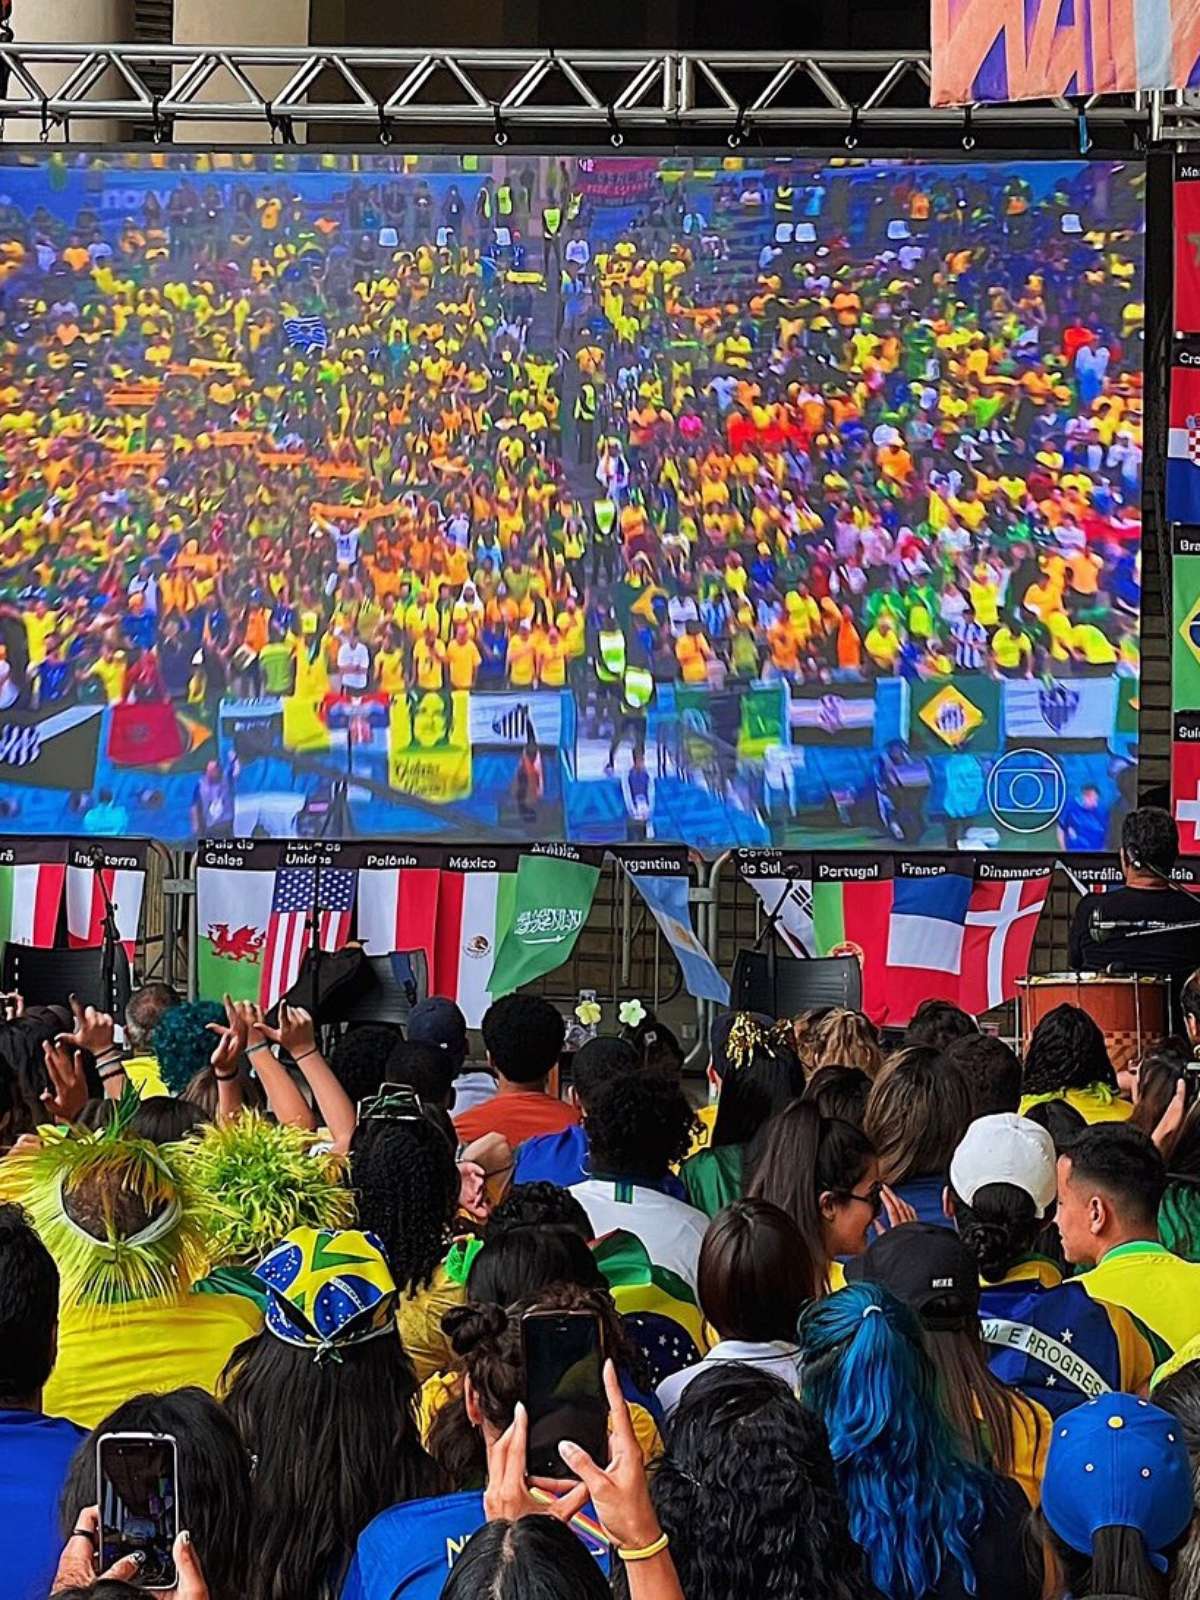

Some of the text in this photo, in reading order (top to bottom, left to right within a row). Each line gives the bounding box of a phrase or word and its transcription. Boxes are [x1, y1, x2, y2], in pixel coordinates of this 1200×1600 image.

[74, 851, 138, 867] Ingterra
[204, 853, 244, 867] Gales
[367, 855, 417, 867] Polônia
[449, 856, 496, 869] México
[740, 861, 781, 875] do Sul
[819, 864, 879, 880] Portugal
[901, 862, 946, 876] França
[979, 864, 1050, 878] Dinamarca
[932, 1278, 953, 1288] NIKE
[1007, 1328, 1024, 1345] E
[1025, 1332, 1110, 1397] PROGRES
